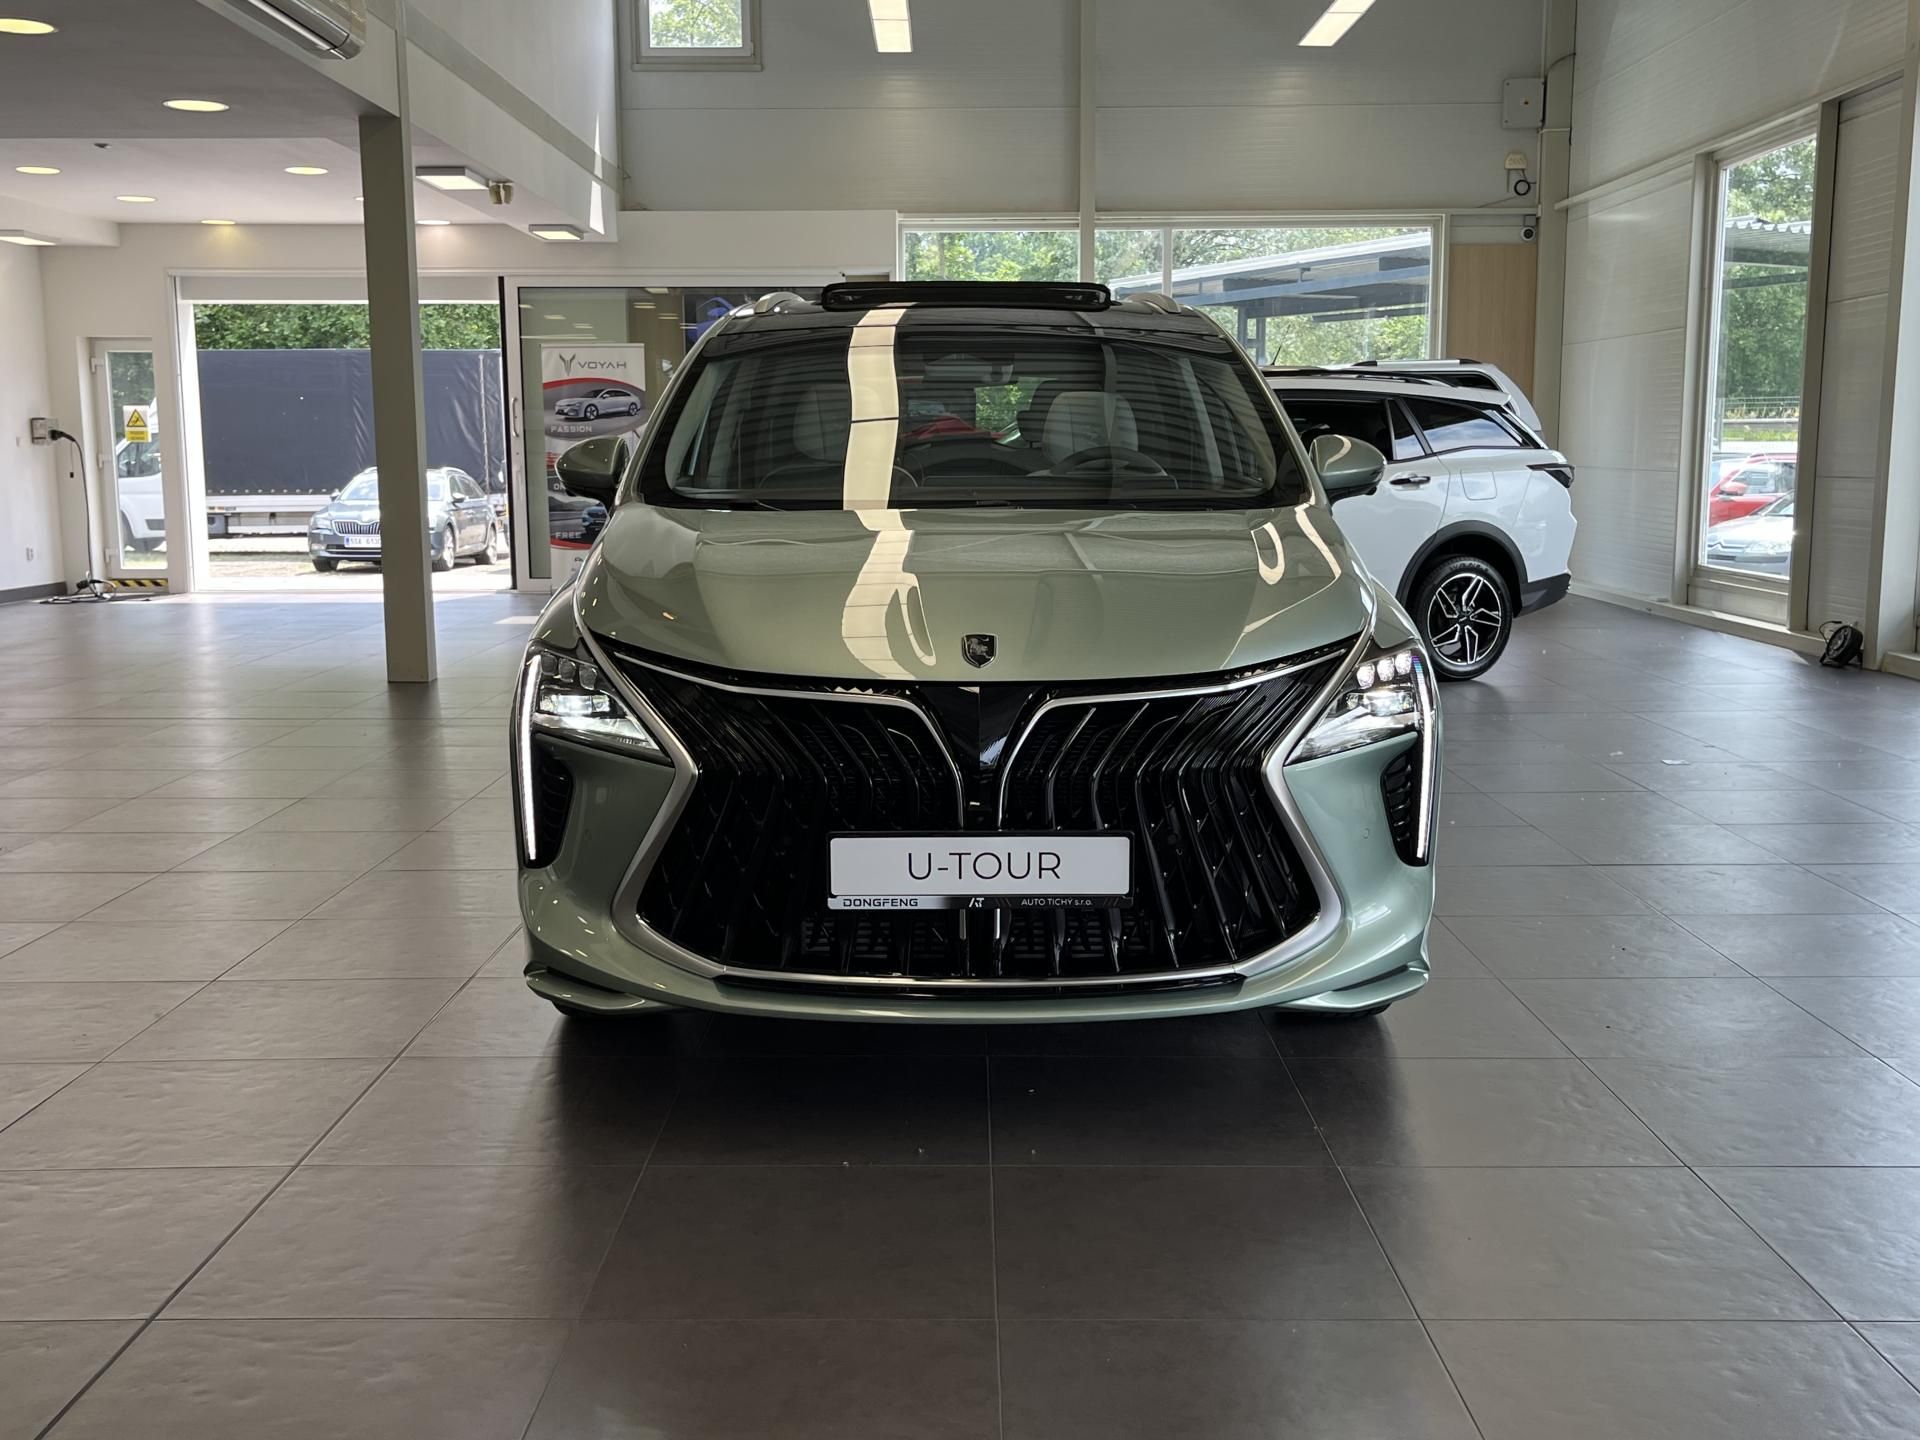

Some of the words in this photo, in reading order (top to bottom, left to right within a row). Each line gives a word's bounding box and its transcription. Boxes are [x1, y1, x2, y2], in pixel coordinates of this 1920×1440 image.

[578, 361, 626, 369] VOYAH
[550, 425, 592, 433] PASSION
[555, 531, 581, 539] FREE
[908, 851, 1061, 880] U-TOUR
[843, 898, 919, 907] DONGFENG
[1021, 898, 1046, 906] AUTO
